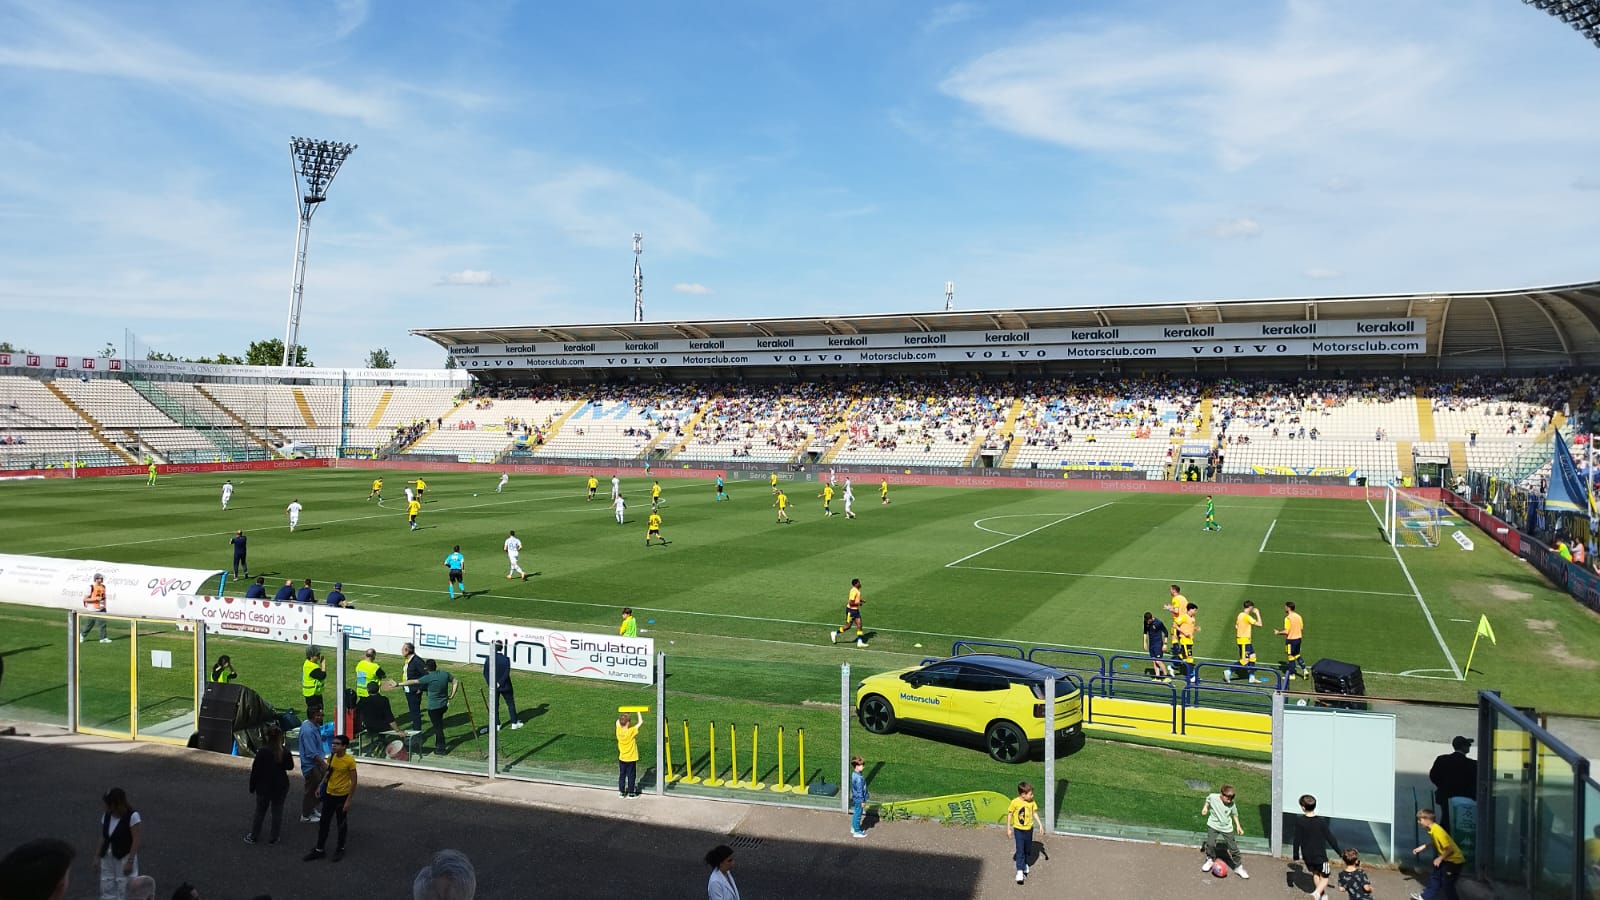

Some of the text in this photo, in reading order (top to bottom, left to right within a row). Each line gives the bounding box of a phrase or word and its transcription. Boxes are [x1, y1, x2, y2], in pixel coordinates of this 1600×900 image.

[450, 321, 1414, 354] kerakoll kerakoll kerakoll kerakoll kerakoll kerakoll kerakoll kerakoll kerakoll kerakoll kerakoll kerakoll kerakoll
[460, 341, 1419, 367] VOLVO Motorsclub.com VOLVO Motorsclub.com VOLVO Motorsclub.com VOLVO Motorsclub.com VOLVO Motorsclub.com
[1269, 485, 1322, 497] betsson
[202, 607, 217, 618] Car
[219, 608, 246, 621] Wash
[249, 611, 275, 624] Cesari
[570, 639, 648, 655] Simulatori
[589, 653, 648, 668] di guida
[608, 670, 648, 680] Maranello
[900, 692, 940, 704] Motorsclub
